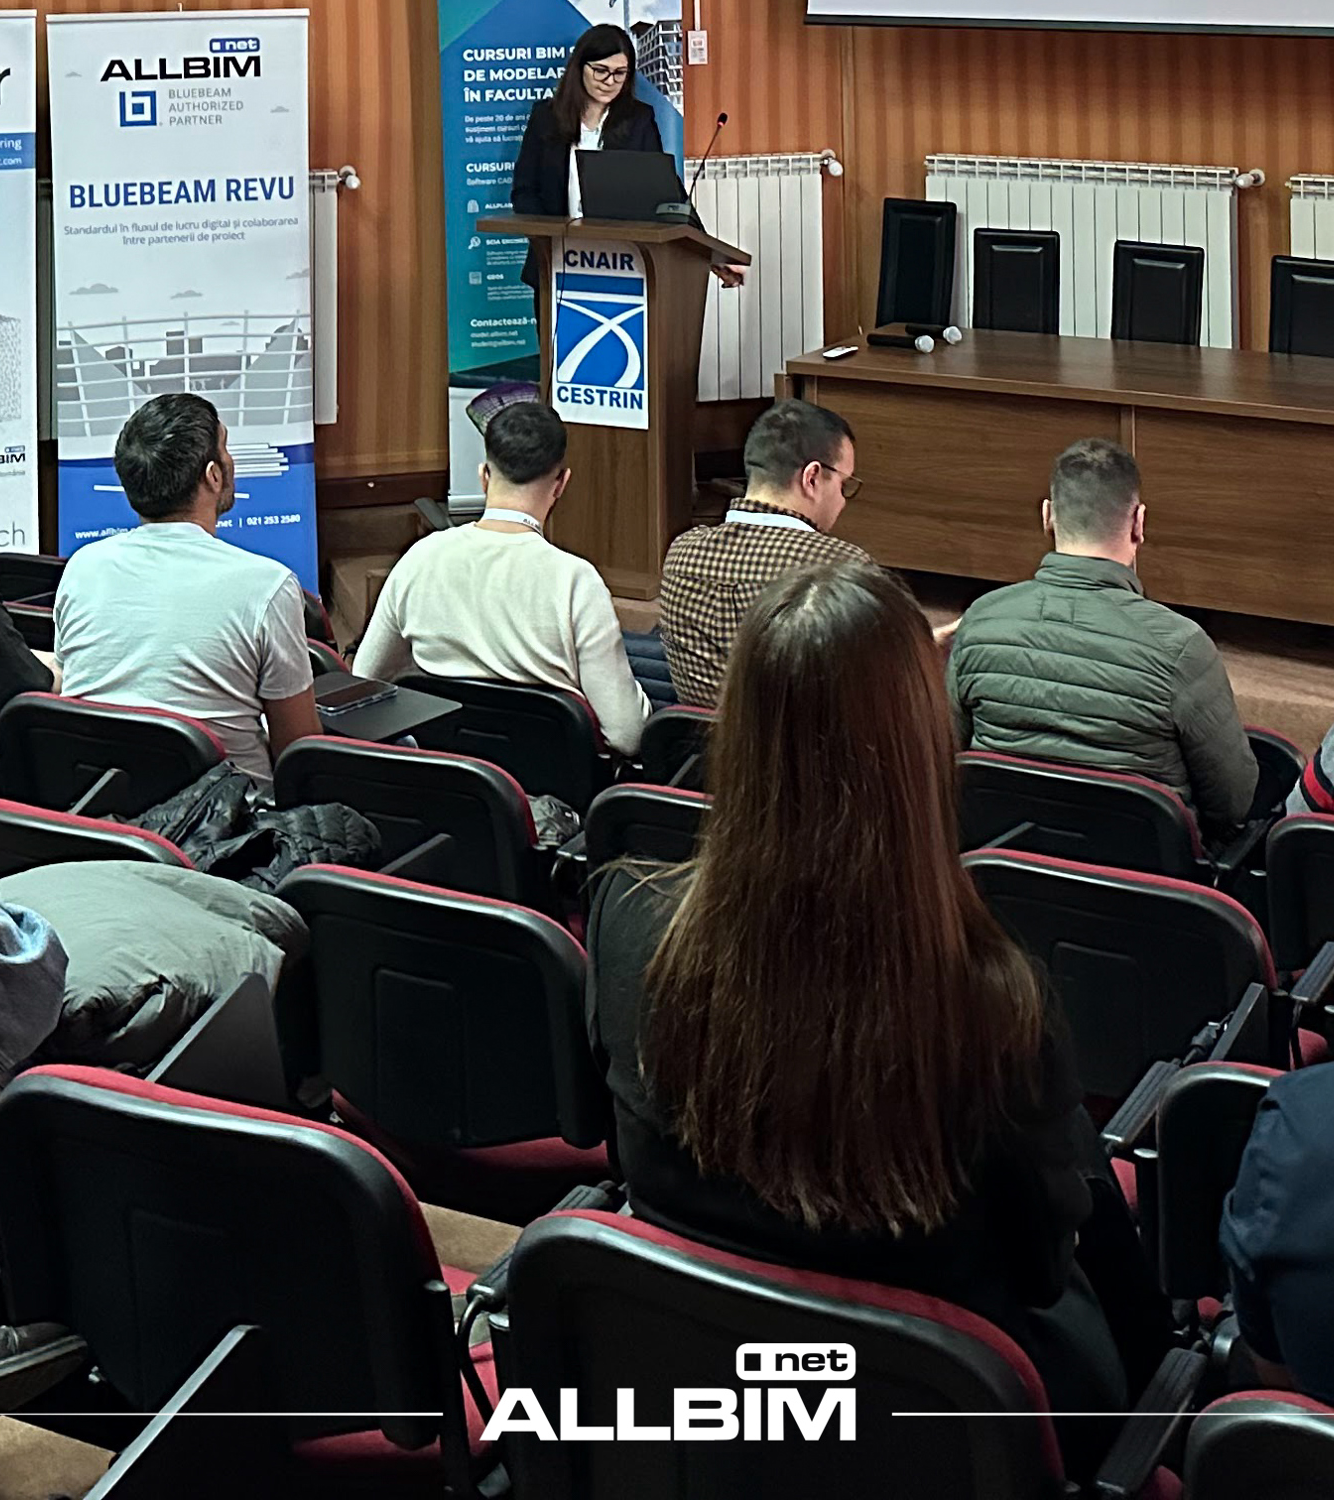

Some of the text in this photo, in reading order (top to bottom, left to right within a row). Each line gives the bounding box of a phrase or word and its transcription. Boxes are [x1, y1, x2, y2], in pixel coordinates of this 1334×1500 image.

[463, 48, 531, 61] CURSURI
[536, 46, 565, 59] BIM
[100, 55, 261, 81] ALLBIM
[464, 67, 566, 82] DE MODELAR
[169, 88, 231, 99] BLUEBEAM
[464, 86, 556, 102] ÎN FACULTA
[169, 101, 244, 112] AUTHORIZED
[169, 115, 222, 126] PARTNER
[466, 162, 515, 173] CURSURI
[70, 176, 295, 208] BLUEBEAM REVU
[565, 249, 635, 271] CNAIR
[557, 386, 643, 410] CESTRIN
